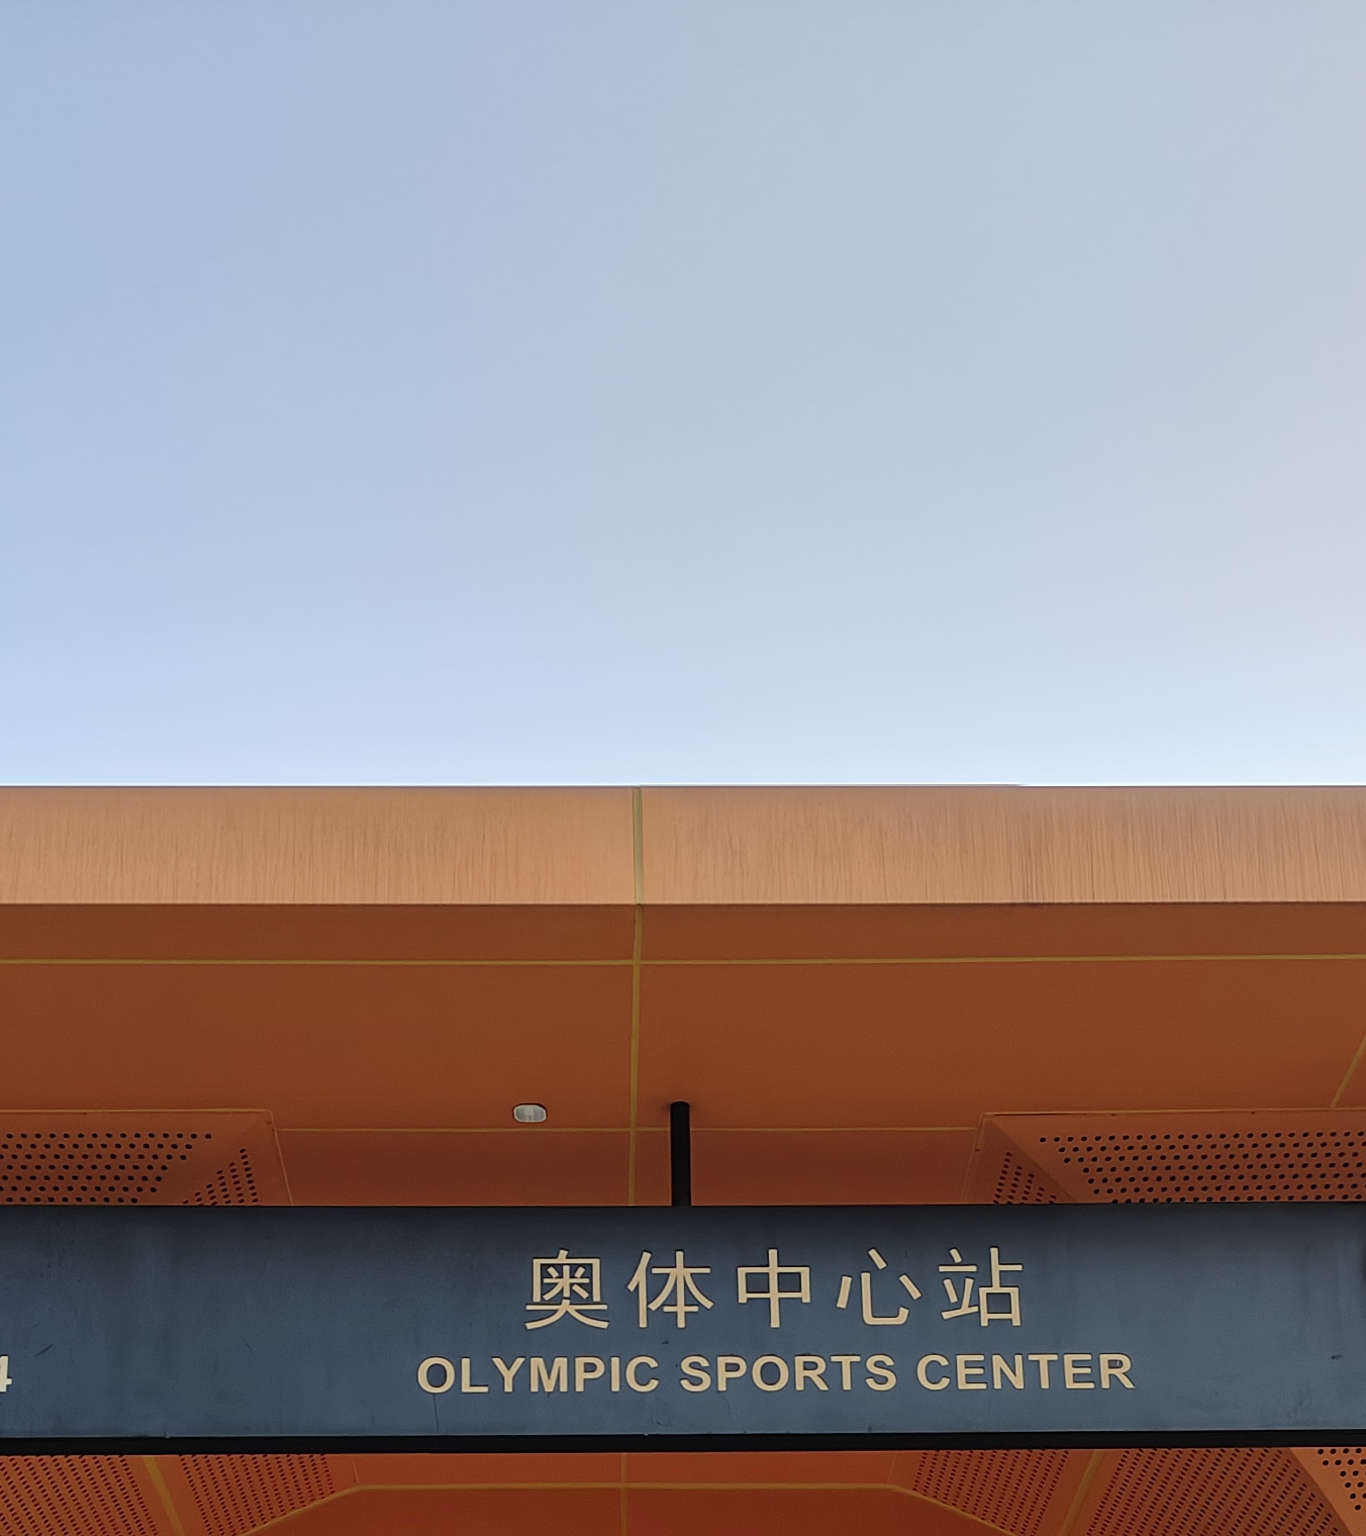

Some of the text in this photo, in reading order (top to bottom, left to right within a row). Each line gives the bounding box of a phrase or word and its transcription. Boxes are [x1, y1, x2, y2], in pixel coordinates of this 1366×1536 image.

[524, 1247, 1024, 1330] 奥体中心站
[417, 1353, 1135, 1394] OLYMPIC SPORTS CENTER
